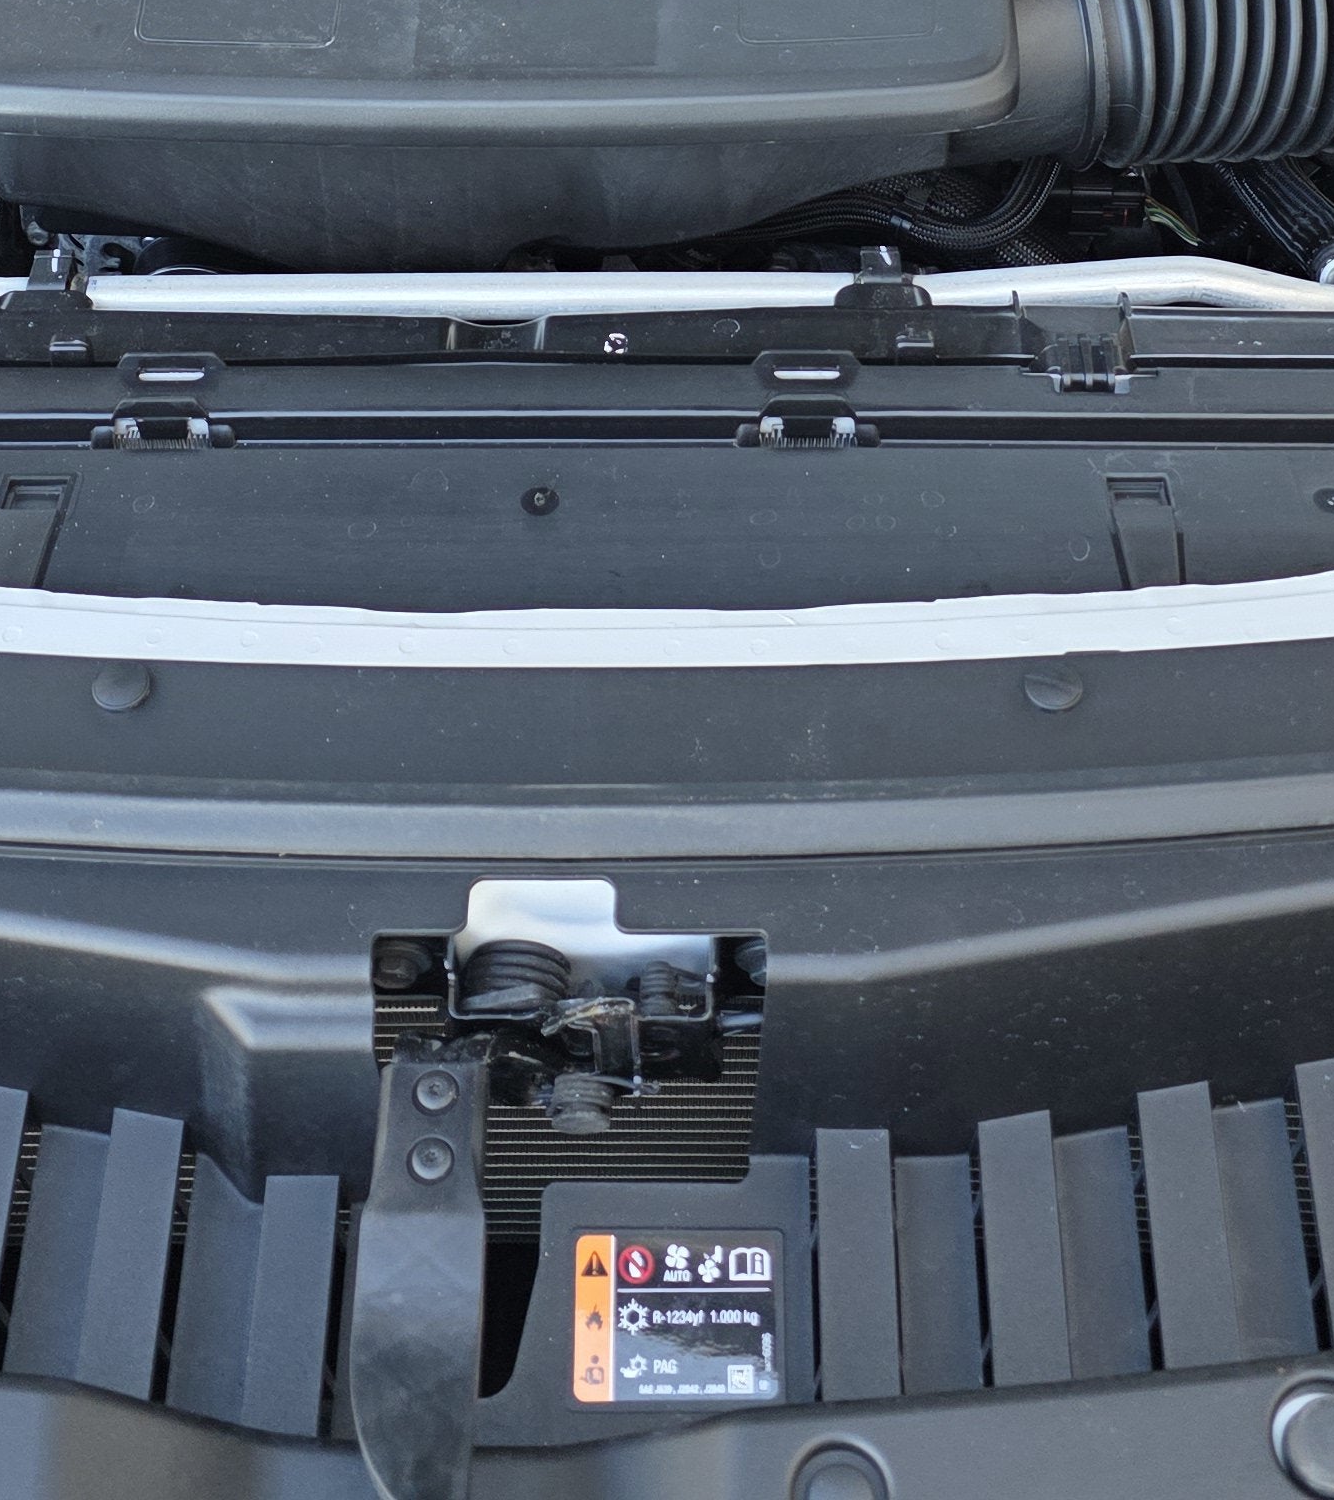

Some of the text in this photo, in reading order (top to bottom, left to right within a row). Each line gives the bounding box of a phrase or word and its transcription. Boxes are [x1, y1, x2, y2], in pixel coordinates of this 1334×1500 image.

[662, 1269, 691, 1283] AUTO
[652, 1309, 760, 1326] R-1234yf 1.000 kg
[653, 1359, 677, 1375] PAG
